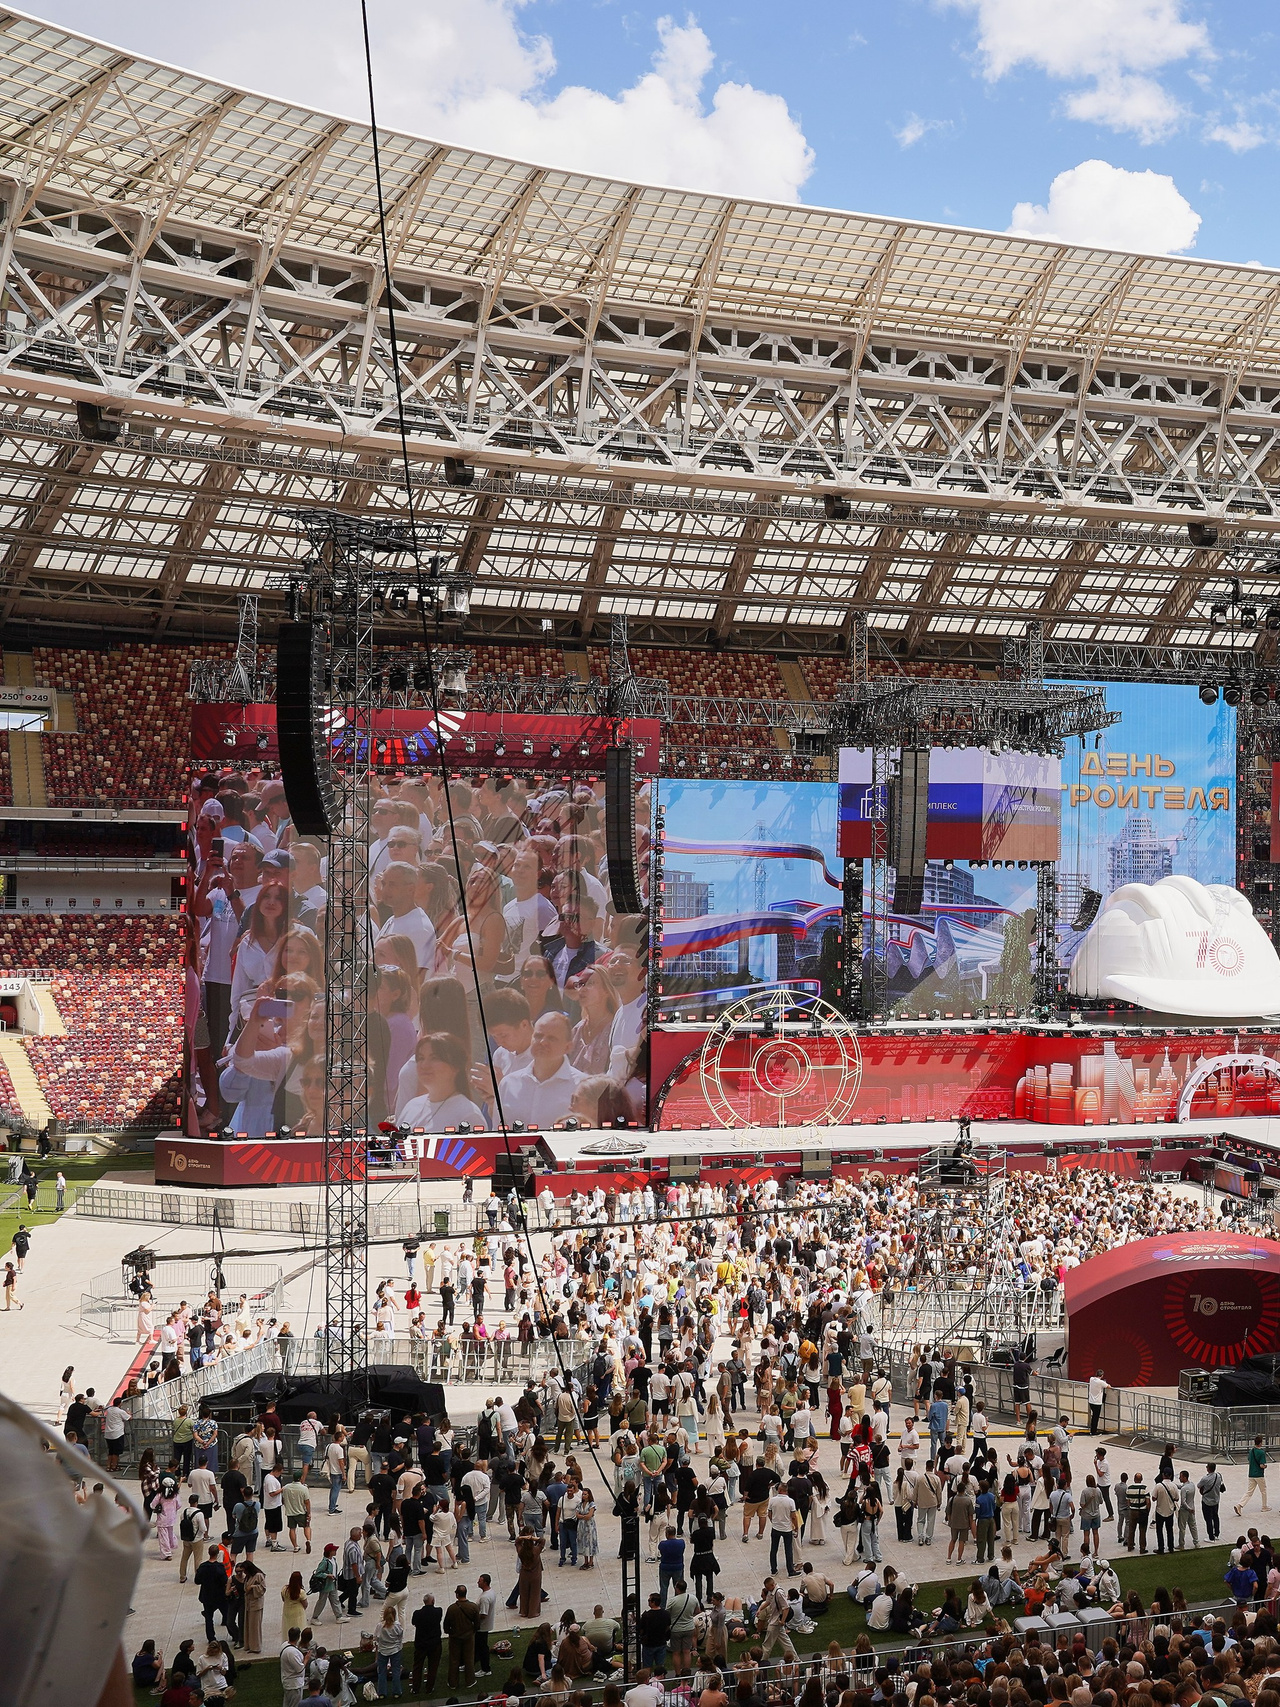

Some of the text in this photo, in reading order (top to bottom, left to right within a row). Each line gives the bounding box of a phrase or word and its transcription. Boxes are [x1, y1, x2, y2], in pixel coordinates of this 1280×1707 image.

[1080, 752, 1176, 778] ДЕНЬ
[168, 1150, 187, 1171] 70
[1190, 1294, 1218, 1316] 70
